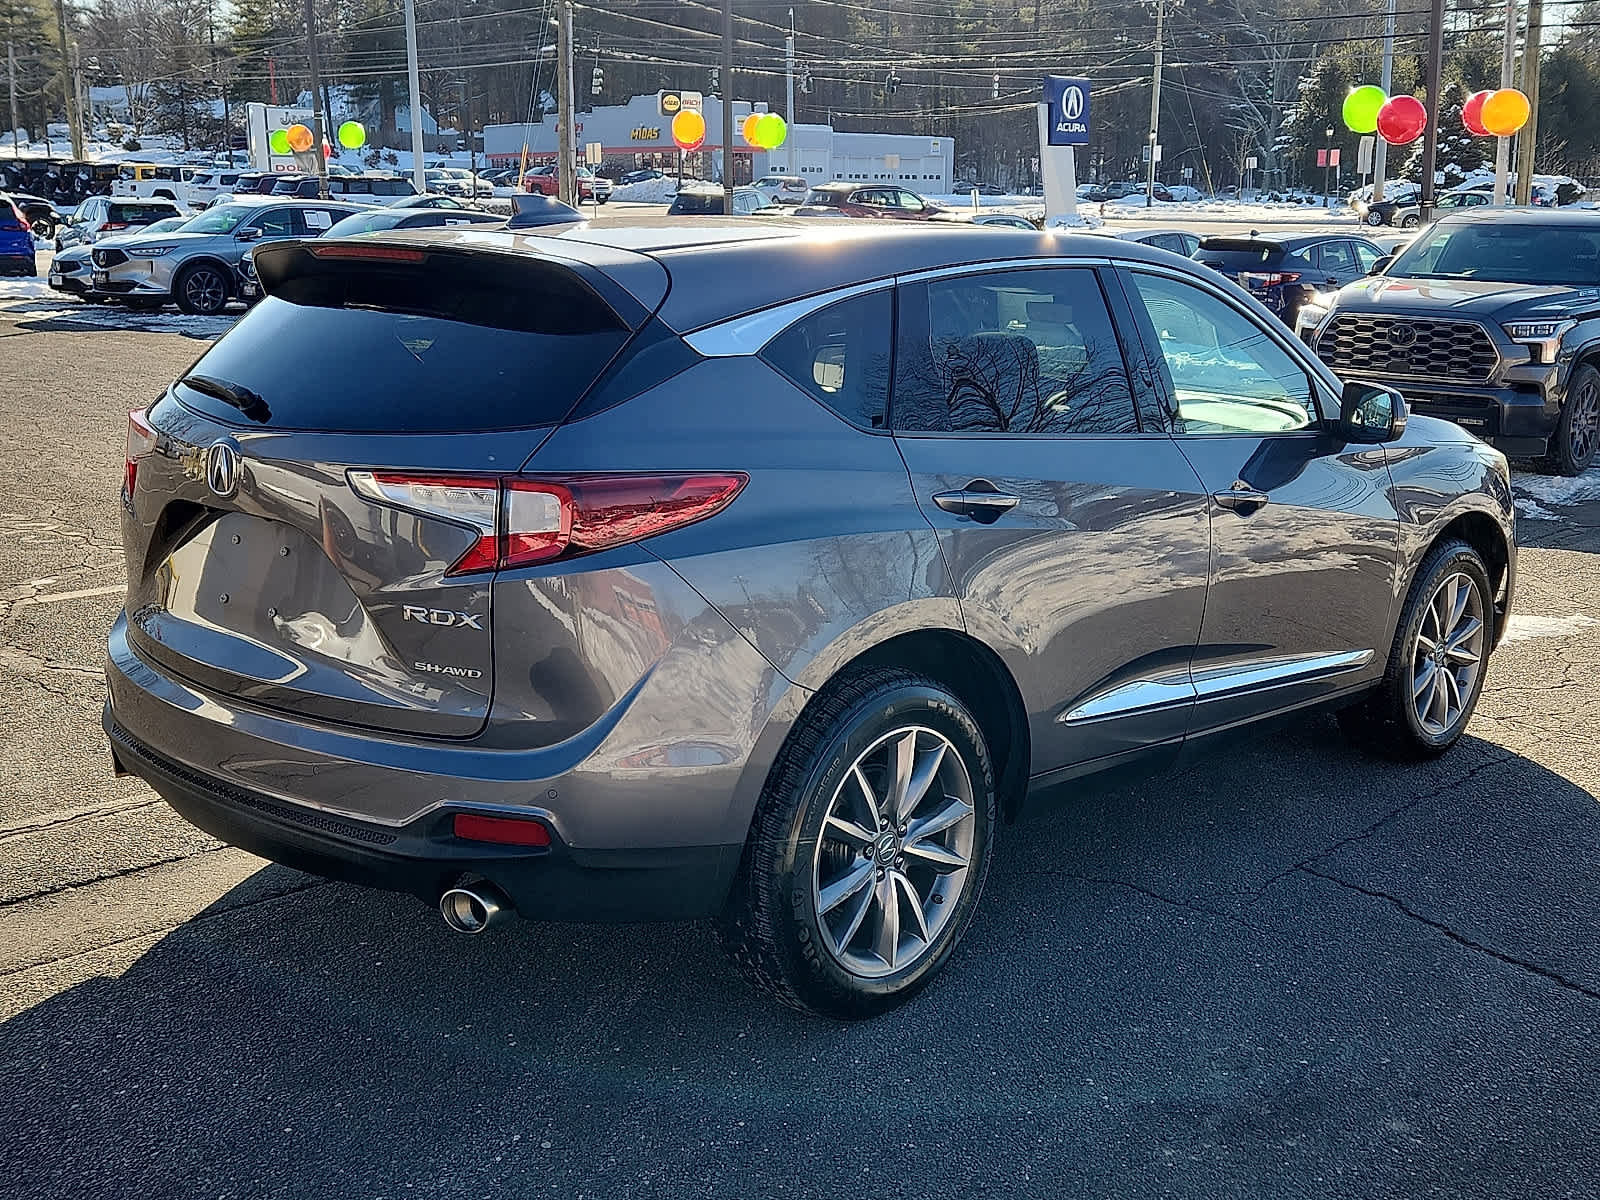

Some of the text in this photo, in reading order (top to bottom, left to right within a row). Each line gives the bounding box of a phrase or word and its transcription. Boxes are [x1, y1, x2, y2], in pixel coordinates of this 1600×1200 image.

[630, 127, 660, 140] MIDAS
[1056, 122, 1087, 133] ACURA
[402, 604, 484, 631] RDX
